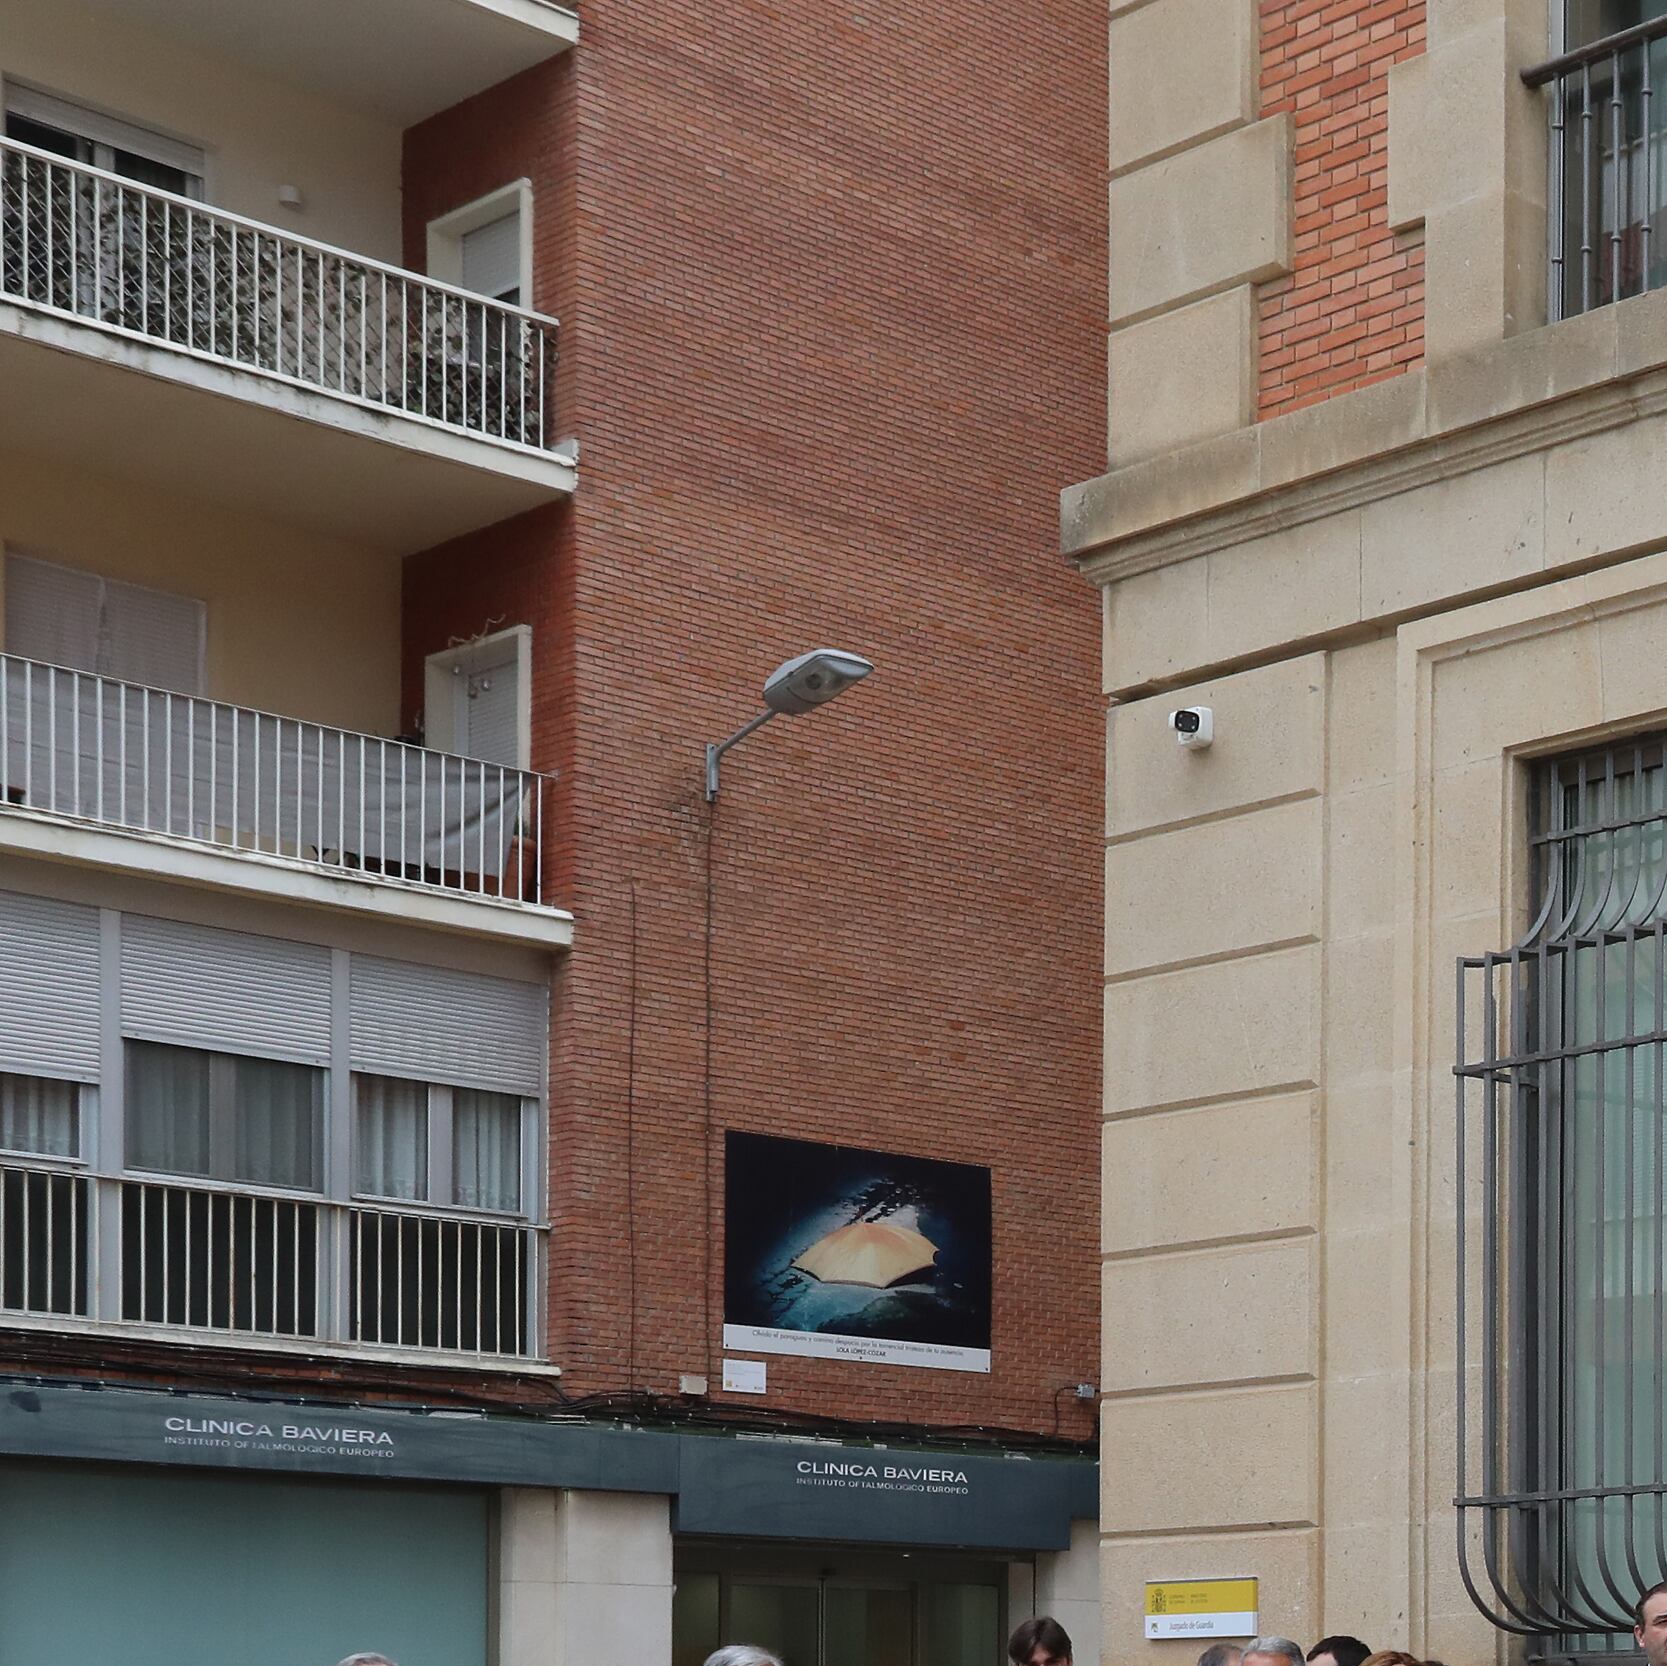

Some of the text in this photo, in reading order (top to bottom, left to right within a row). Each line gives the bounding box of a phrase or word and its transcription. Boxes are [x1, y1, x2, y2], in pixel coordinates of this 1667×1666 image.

[164, 1416, 394, 1445] CLINICA BAVIERA
[164, 1436, 230, 1448] INSTITUTO
[339, 1447, 394, 1458] EUROPEO
[797, 1460, 968, 1484] CLINICA BAVIERA
[796, 1477, 846, 1487] INSTITUTO
[926, 1485, 969, 1495] EUROPEO
[1195, 1619, 1214, 1630] Guardia
